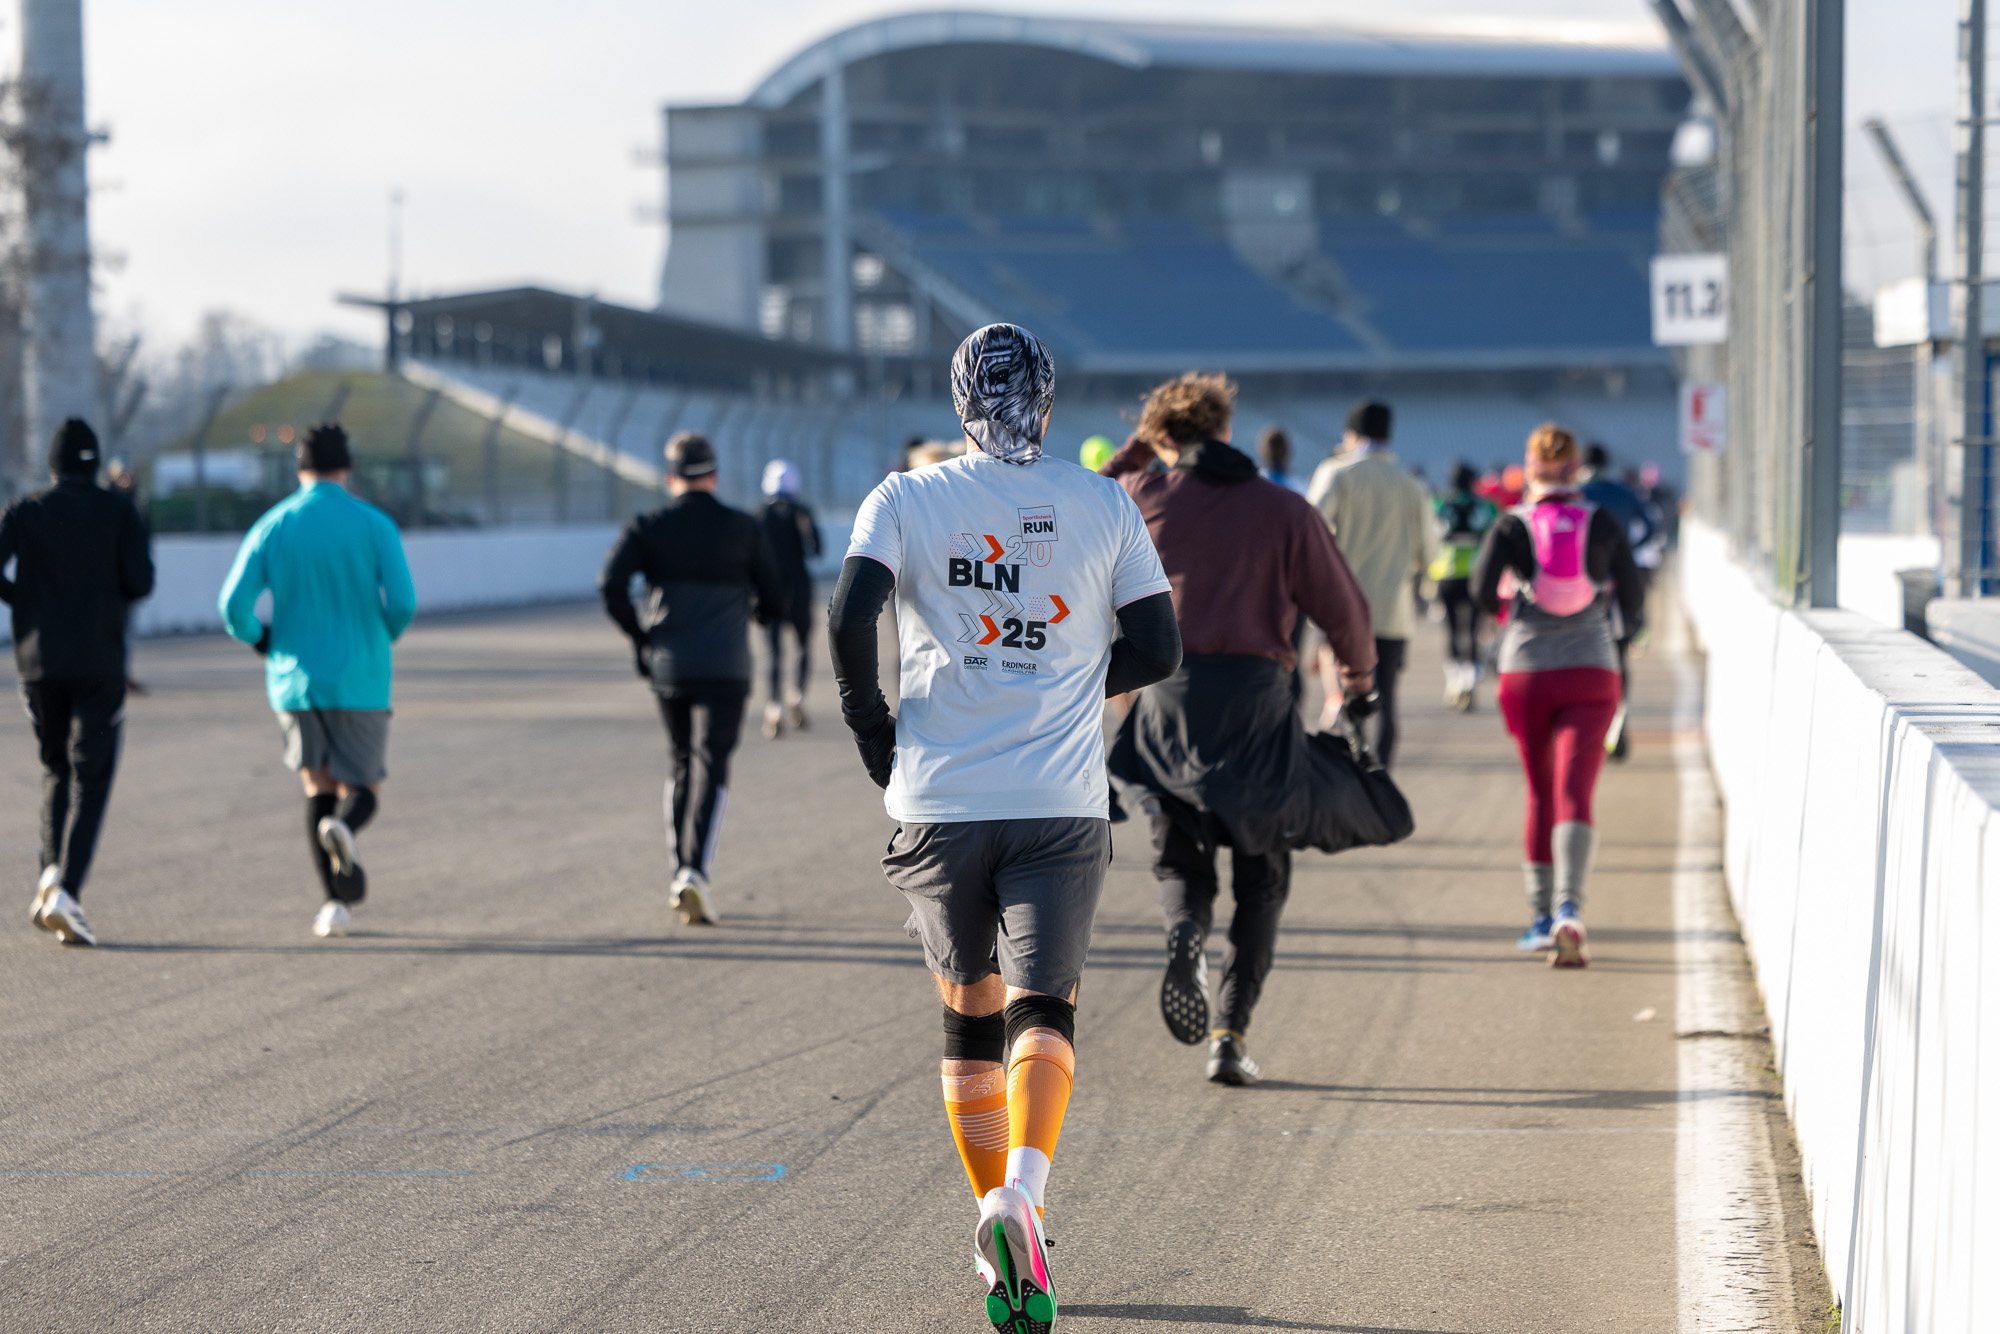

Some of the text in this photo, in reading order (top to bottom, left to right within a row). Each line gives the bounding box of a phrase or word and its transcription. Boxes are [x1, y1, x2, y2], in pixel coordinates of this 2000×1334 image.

[1024, 521, 1054, 533] RUN
[949, 558, 1020, 593] BLN
[1002, 618, 1047, 650] 25
[964, 656, 988, 666] DAK
[1002, 660, 1037, 671] ERDINGER
